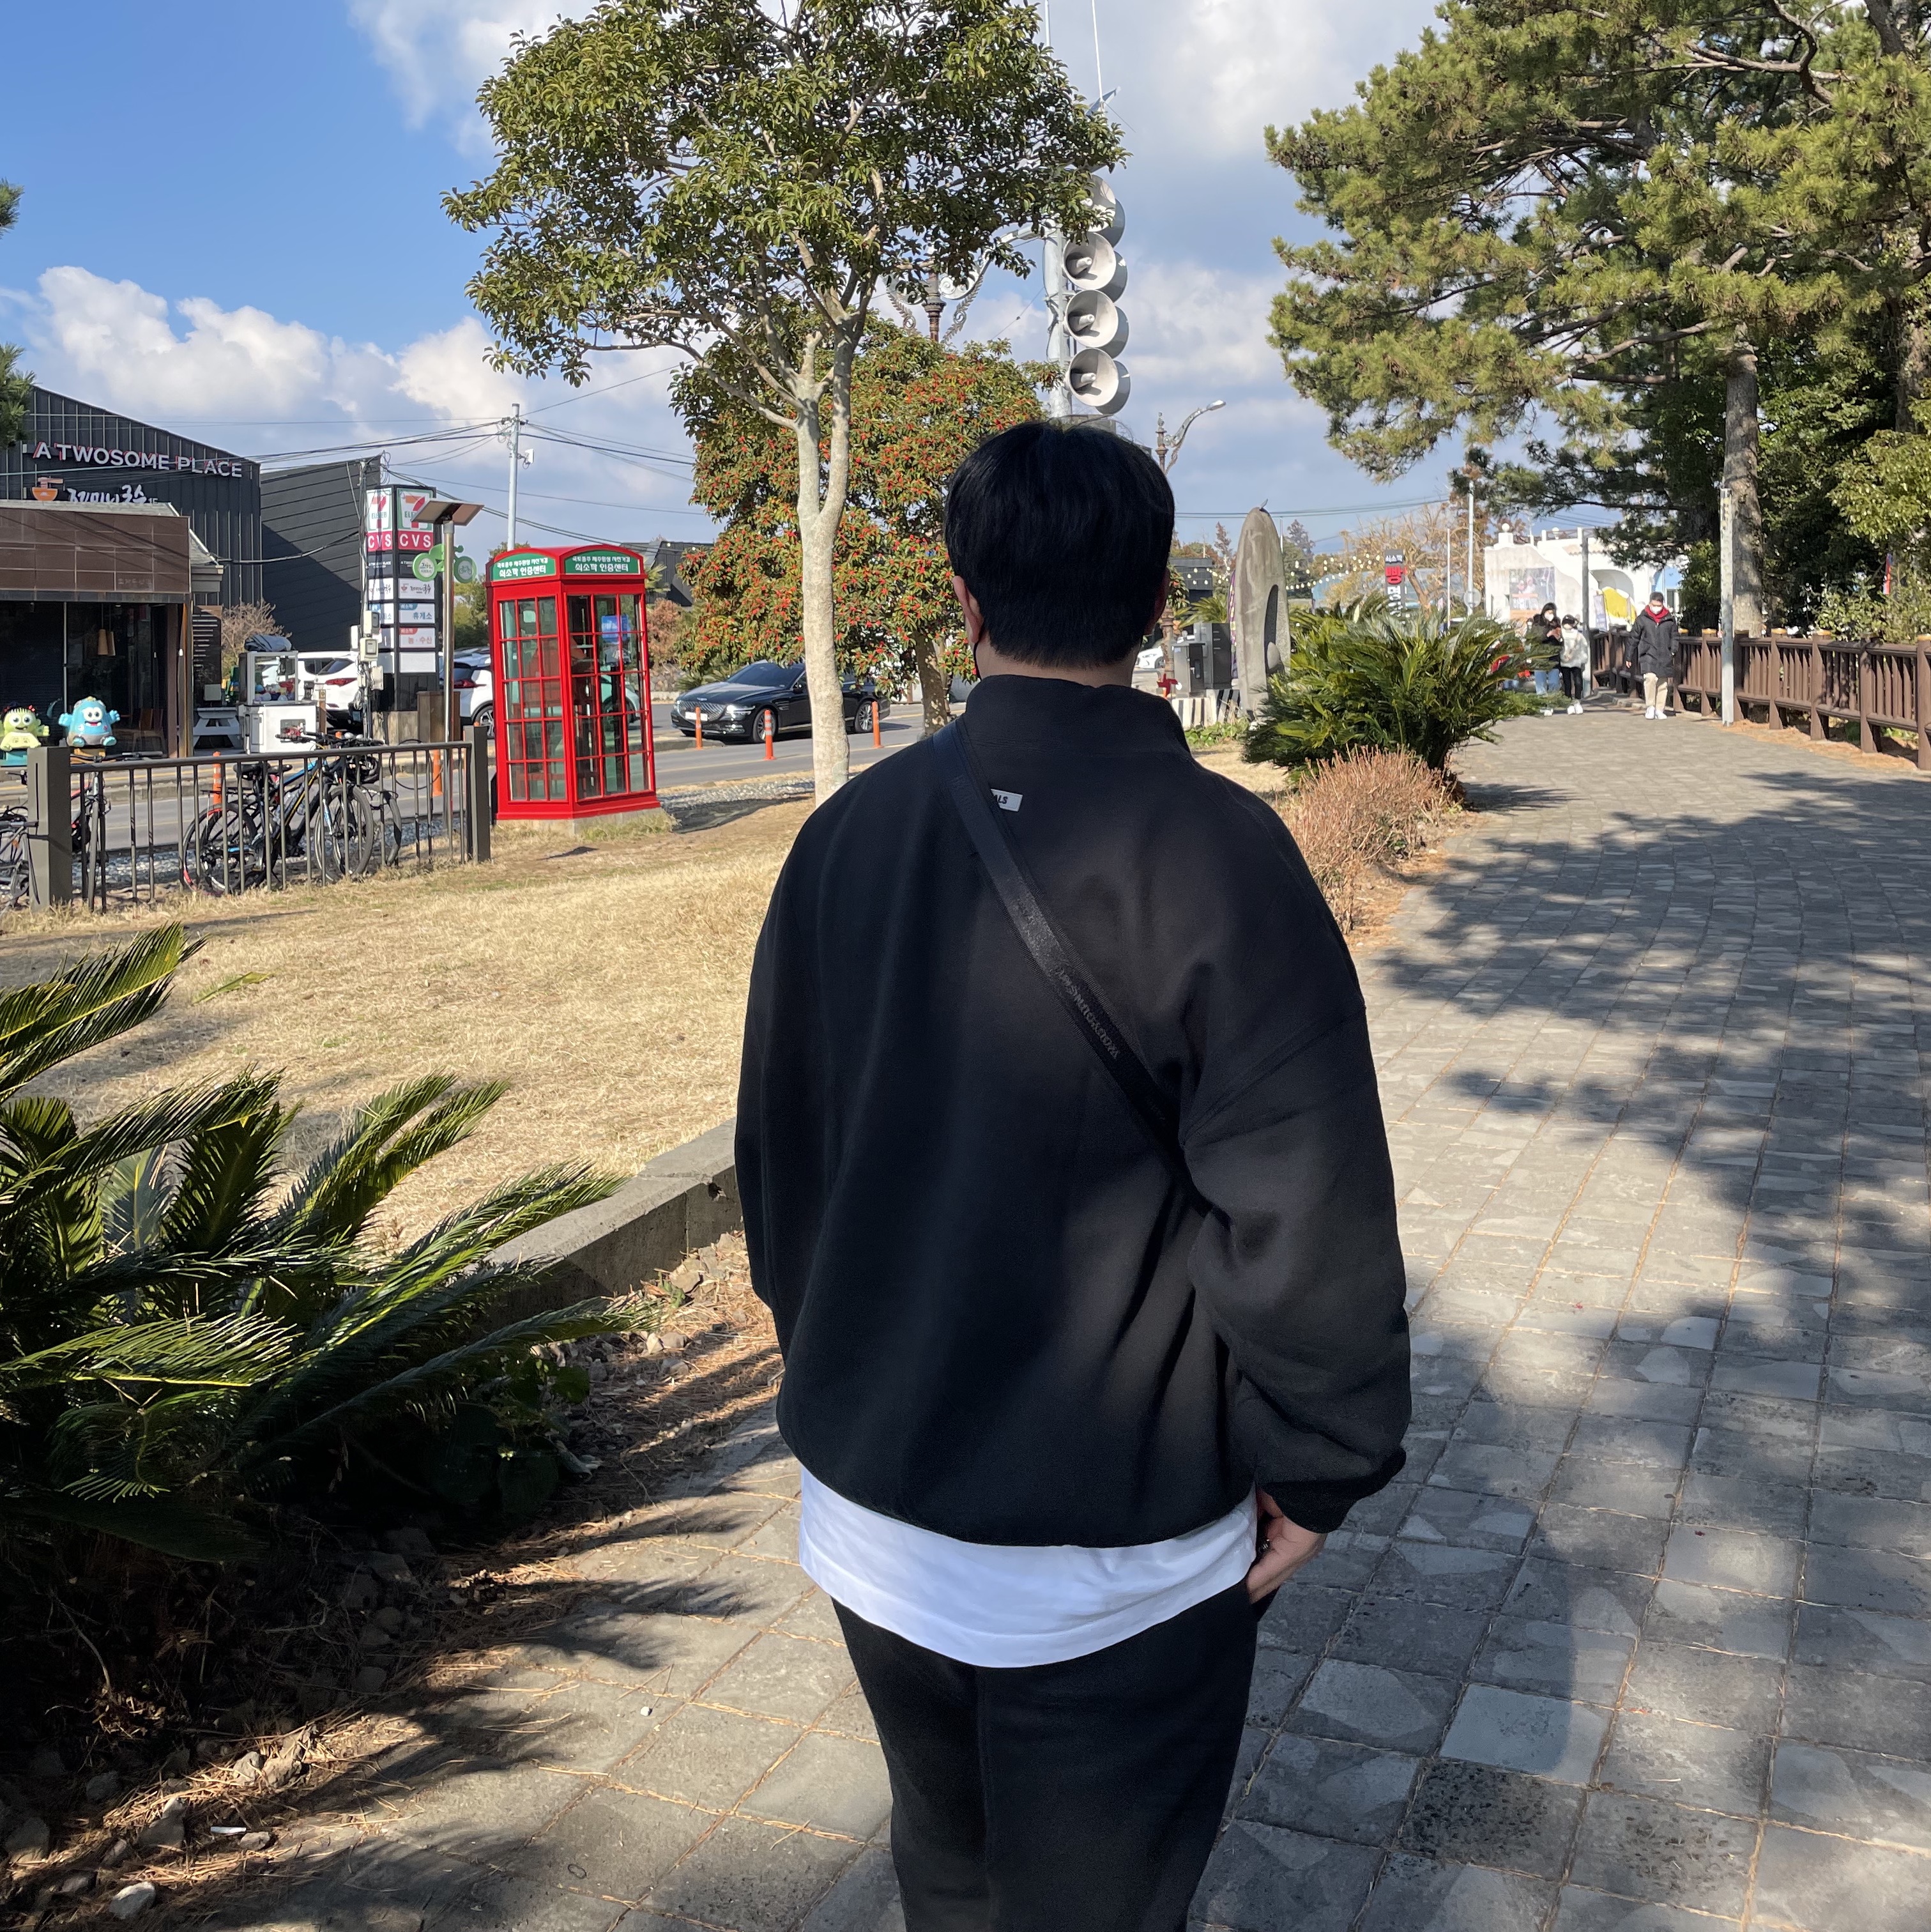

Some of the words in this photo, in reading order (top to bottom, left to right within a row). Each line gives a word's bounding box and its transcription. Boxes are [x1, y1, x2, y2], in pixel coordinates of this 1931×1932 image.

[33, 441, 52, 459] A
[55, 442, 170, 471] TWOSOME
[177, 455, 243, 478] PLACE
[367, 533, 392, 548] CVS
[399, 533, 431, 548] CVS
[499, 568, 519, 578] 쇠소깍
[520, 565, 546, 576] 인증센터
[575, 563, 597, 572] 쇠소깍
[599, 563, 629, 572] 인증센터
